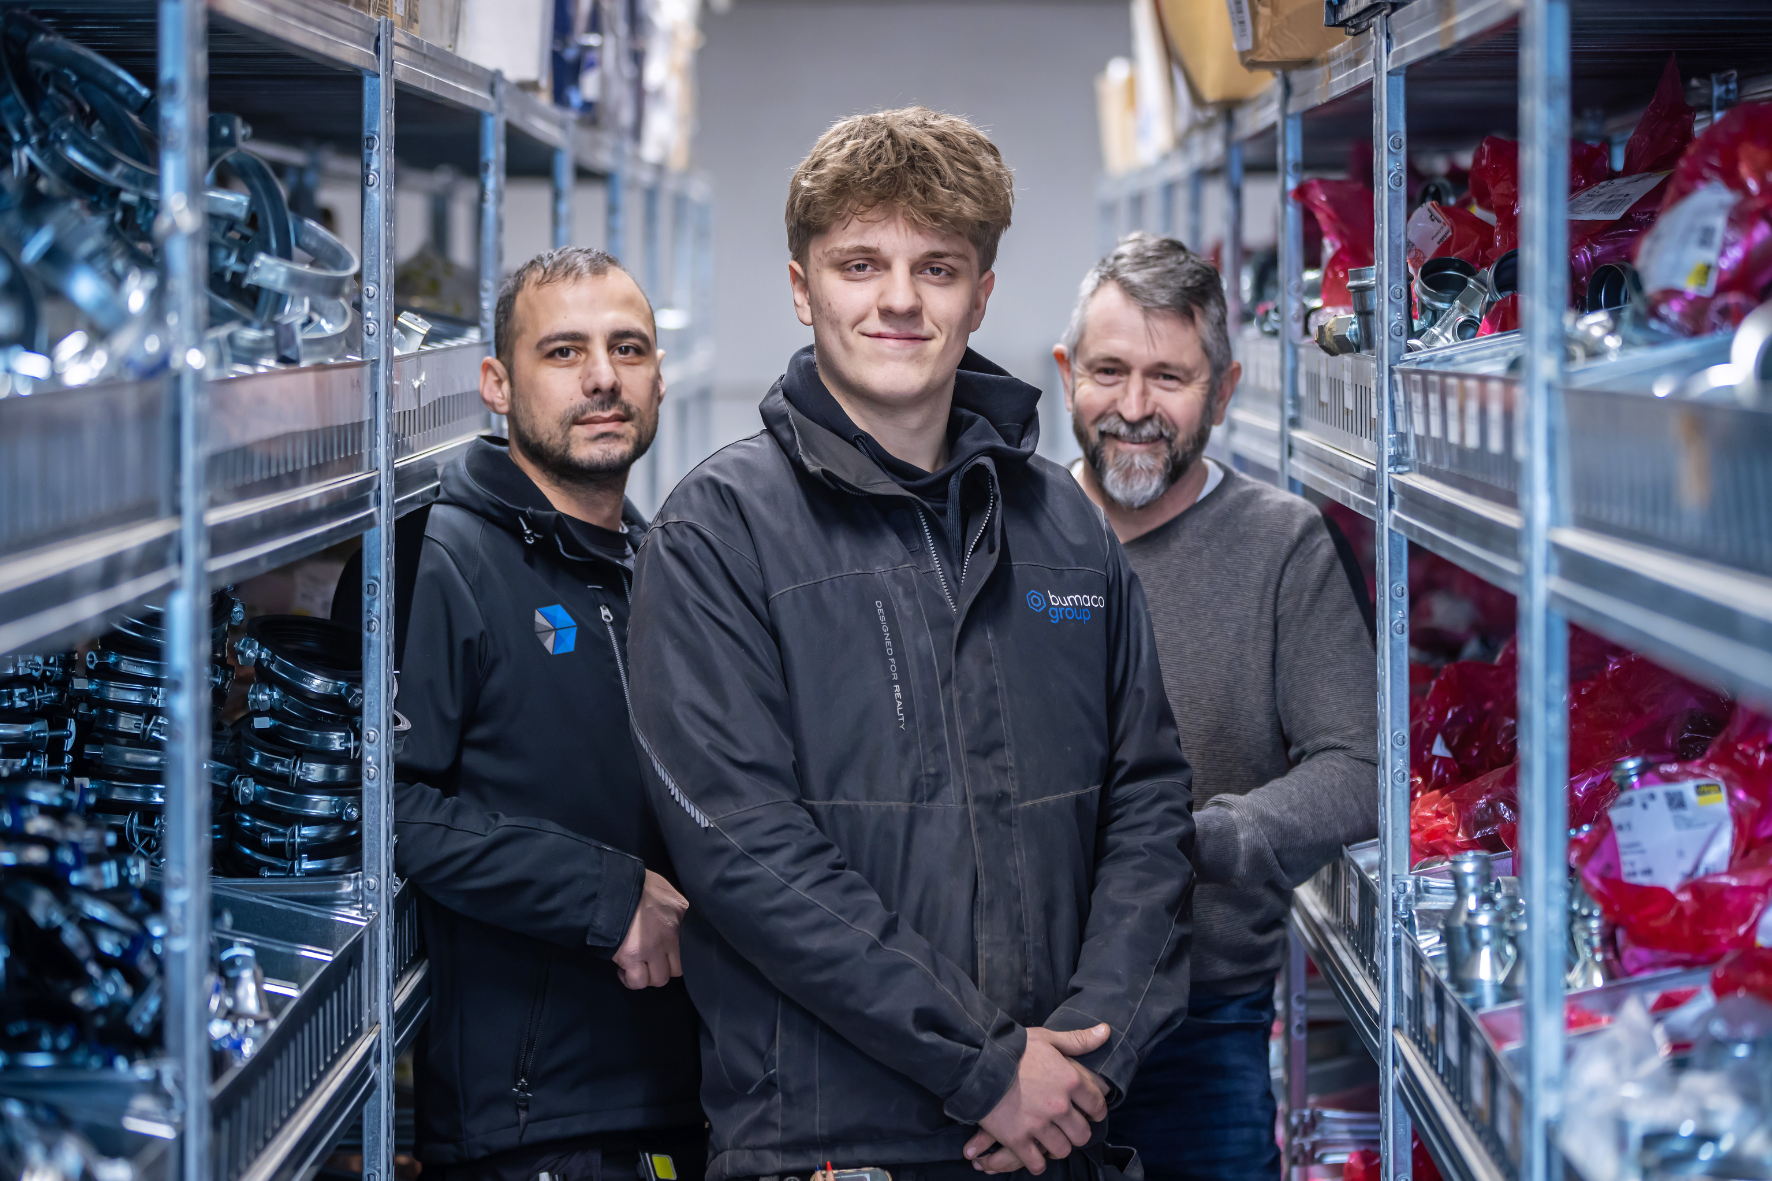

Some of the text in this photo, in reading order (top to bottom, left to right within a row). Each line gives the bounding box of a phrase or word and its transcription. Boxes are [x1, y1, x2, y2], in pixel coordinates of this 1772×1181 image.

[1047, 590, 1105, 608] bumaco
[1048, 607, 1091, 624] group
[875, 600, 906, 731] DESIGNED FOR REALITY
